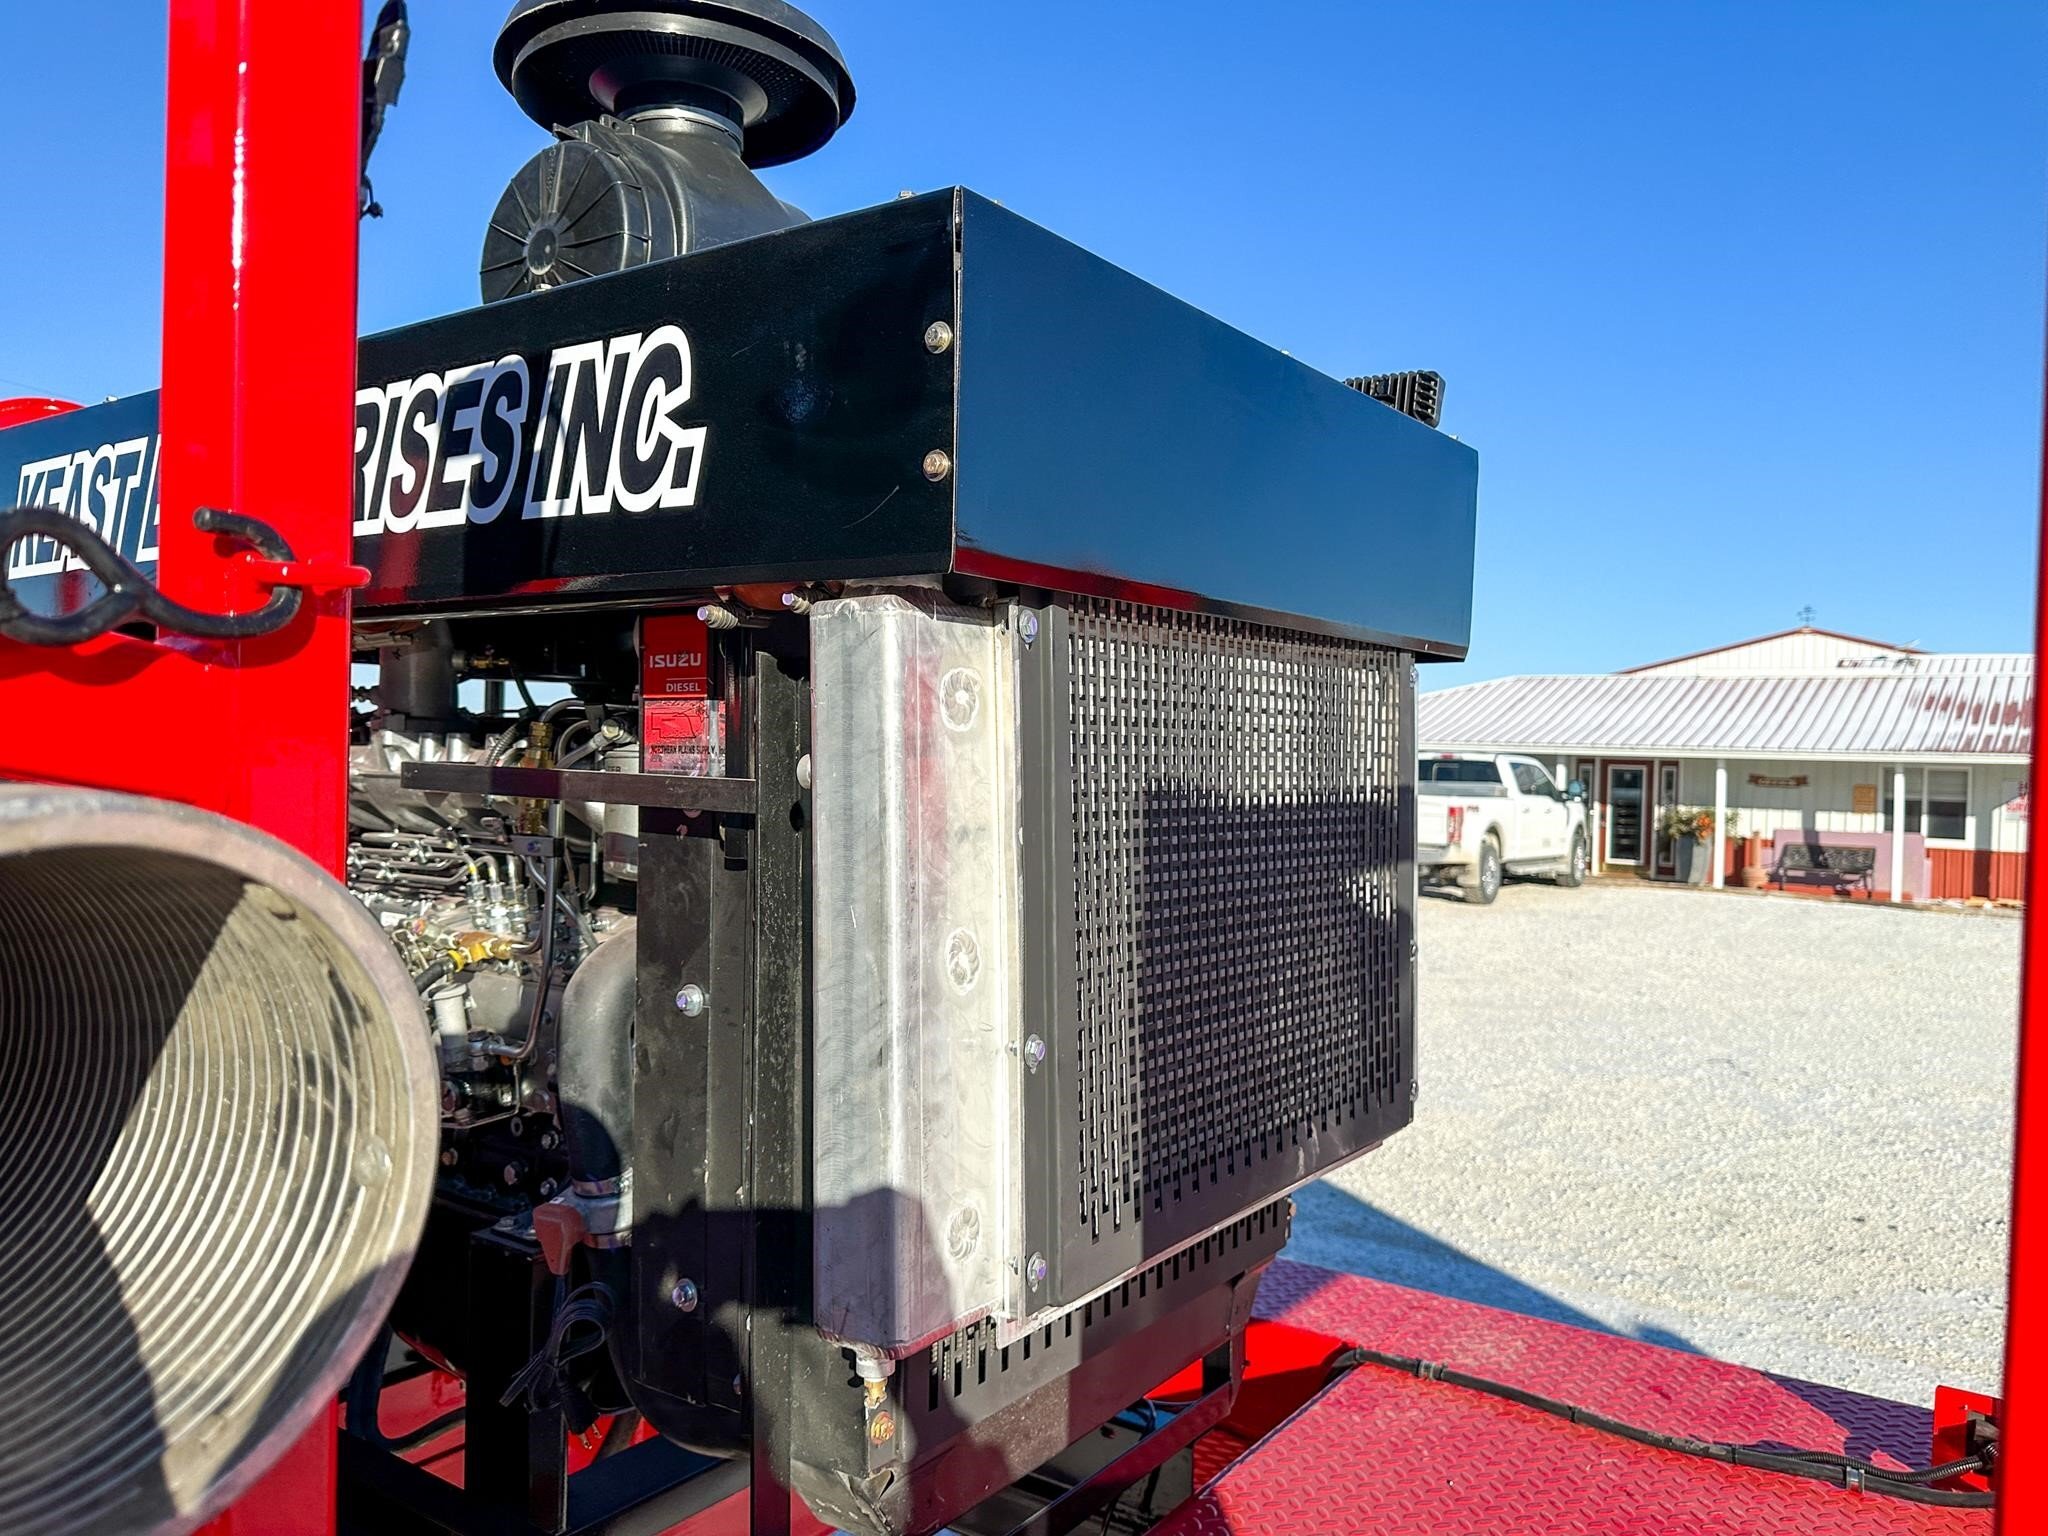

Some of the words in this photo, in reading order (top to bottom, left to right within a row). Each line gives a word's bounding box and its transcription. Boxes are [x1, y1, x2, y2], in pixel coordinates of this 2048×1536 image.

[8, 436, 149, 581] KEAST
[522, 324, 708, 521] INC.
[649, 653, 701, 668] ISUZU
[666, 682, 701, 692] DIESEL
